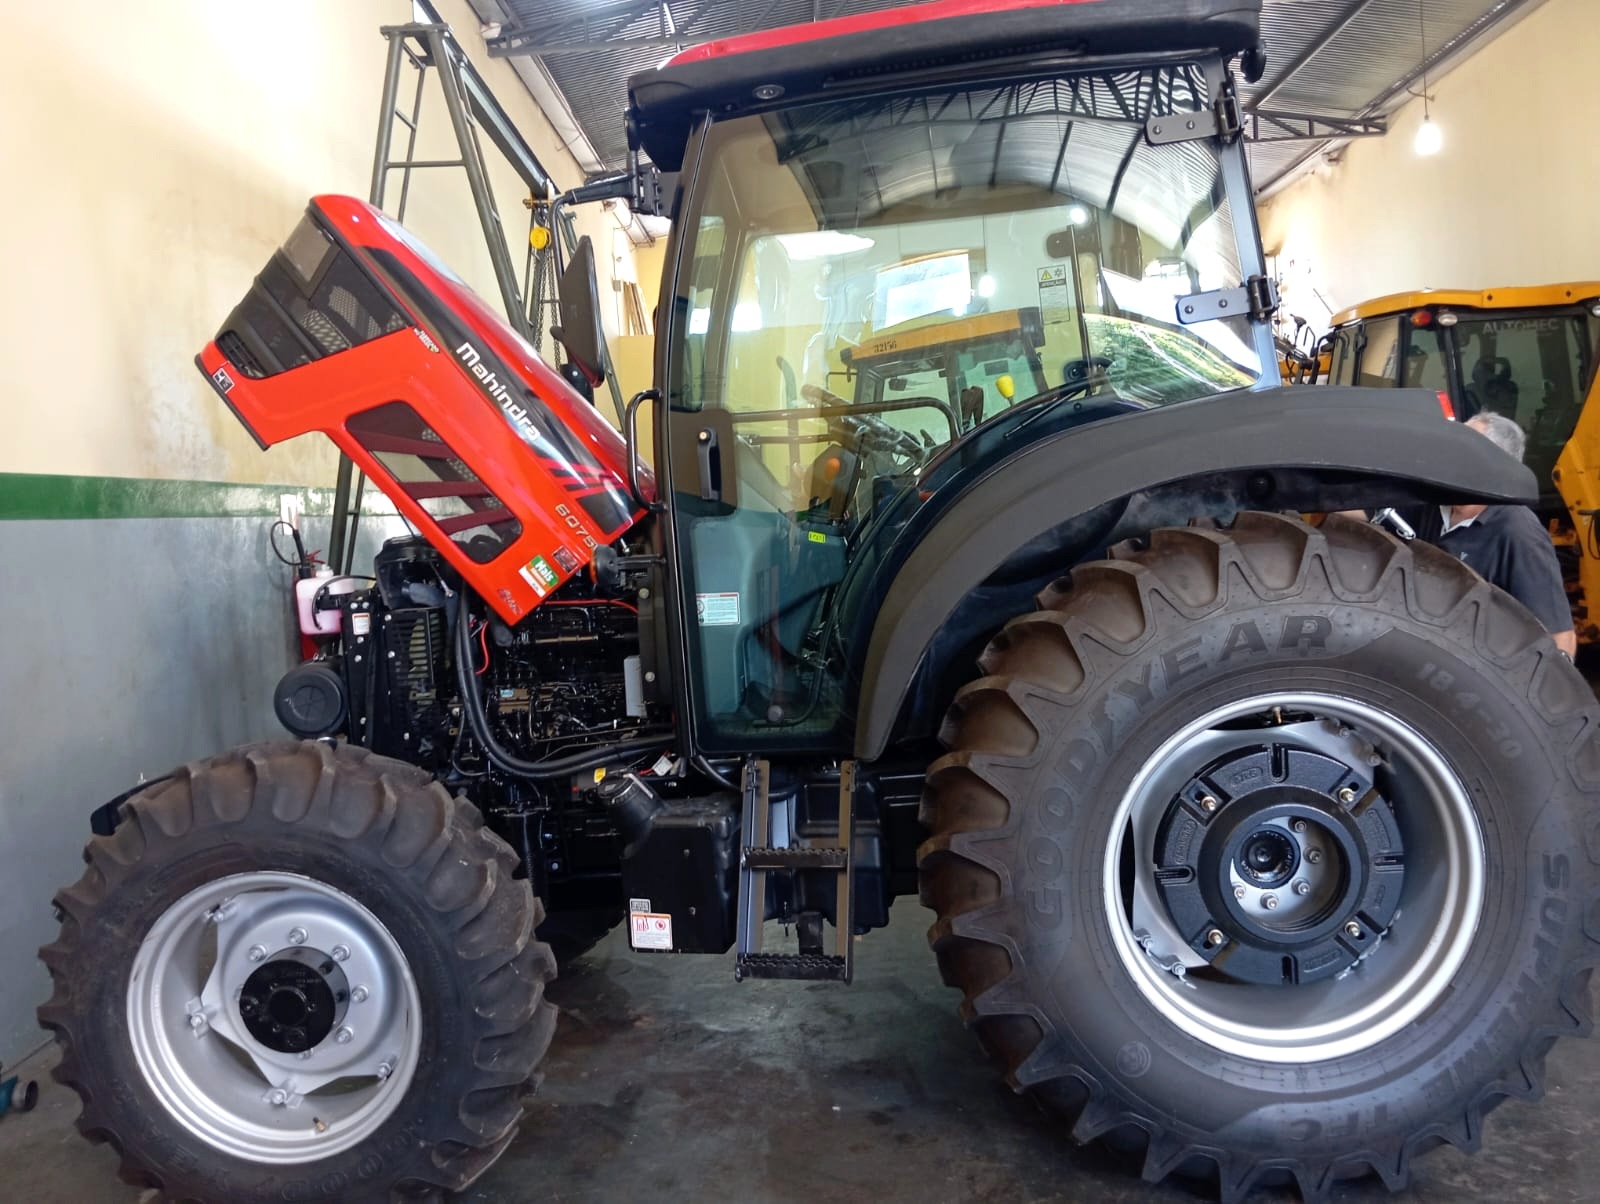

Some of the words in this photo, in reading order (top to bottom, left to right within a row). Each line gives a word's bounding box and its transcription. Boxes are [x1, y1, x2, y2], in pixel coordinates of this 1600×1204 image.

[456, 341, 541, 441] Mahindra
[555, 504, 597, 549] 6075
[1024, 616, 1333, 929] GOODYEAR
